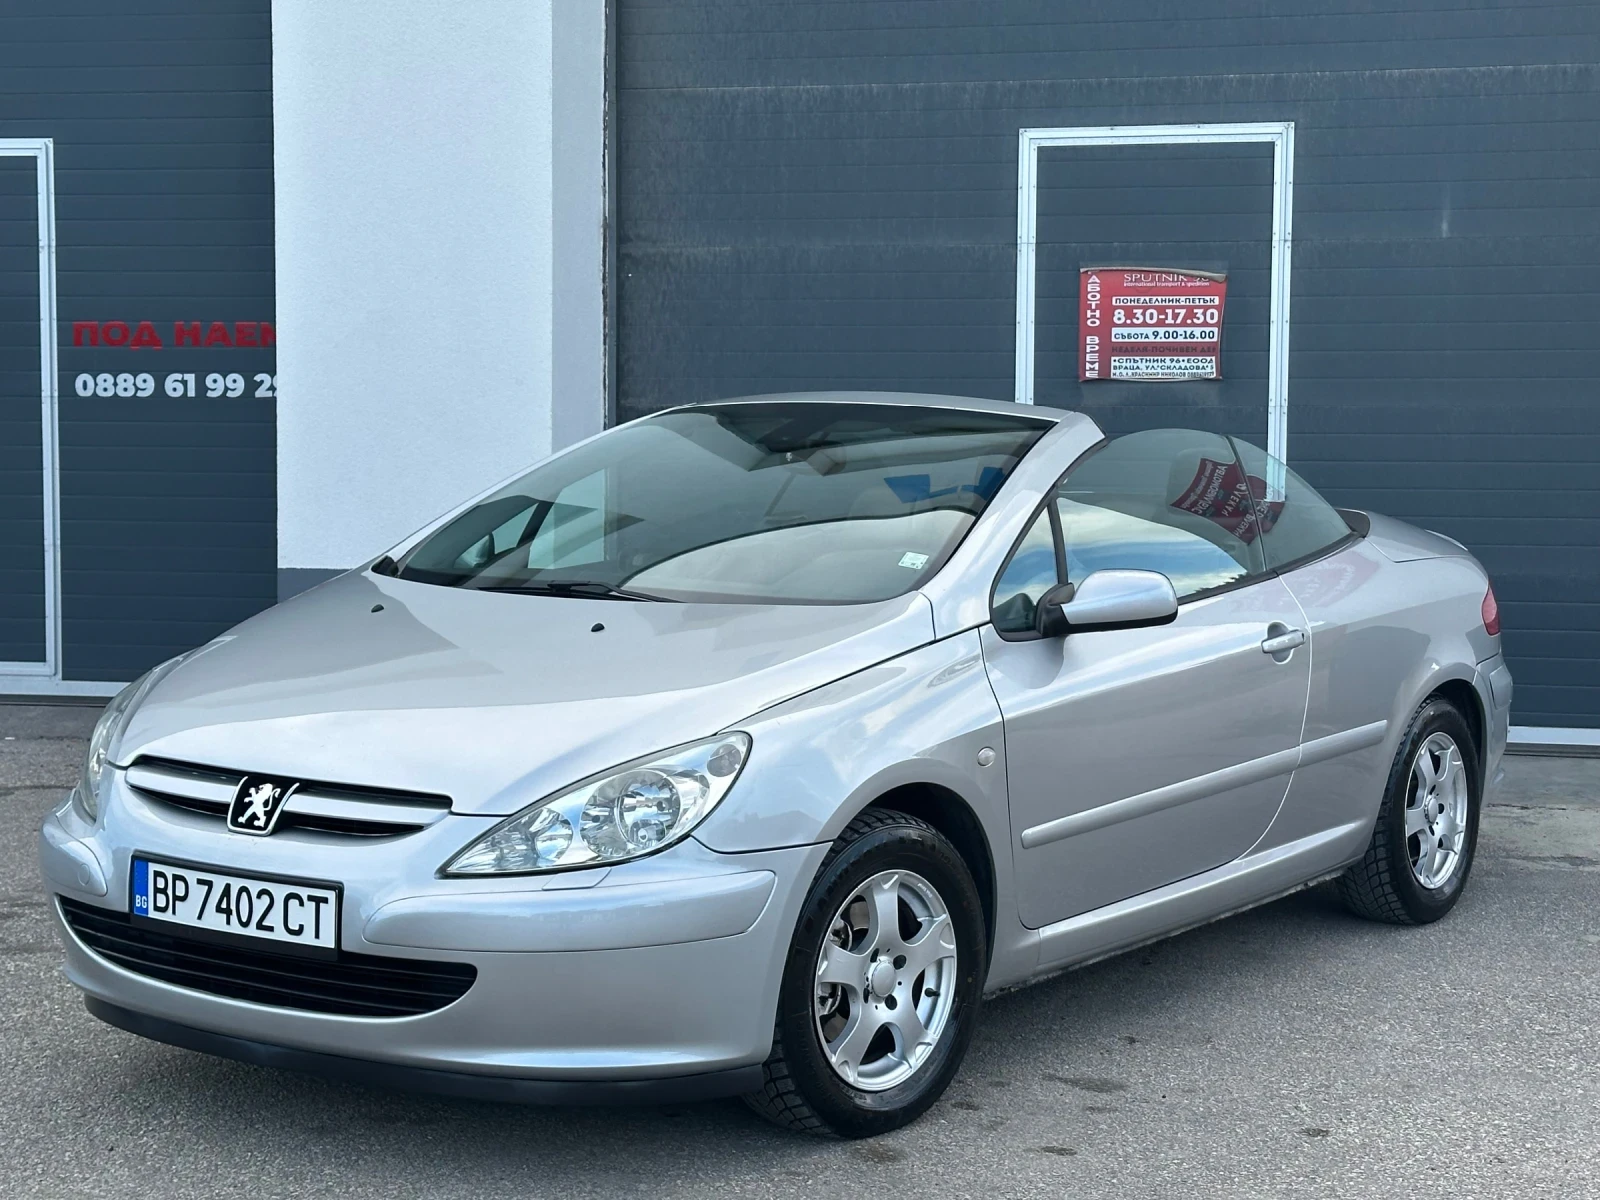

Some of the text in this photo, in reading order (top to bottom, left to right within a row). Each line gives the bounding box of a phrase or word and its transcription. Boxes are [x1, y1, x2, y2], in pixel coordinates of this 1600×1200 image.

[1123, 273, 1188, 282] SPUTNIK
[1114, 297, 1216, 305] ПОНЕДЕЛНИК-ПЕТЪК
[1085, 271, 1101, 378] АБОТНО ВРЕМЕ
[1113, 308, 1219, 325] 8.30-17.30
[72, 321, 163, 350] ПОД
[1113, 330, 1215, 340] СЪБОТА 9.00-16.00
[75, 373, 277, 398] 0889 61 99 2
[135, 895, 148, 909] BG
[153, 870, 329, 940] BP 7402 CT
